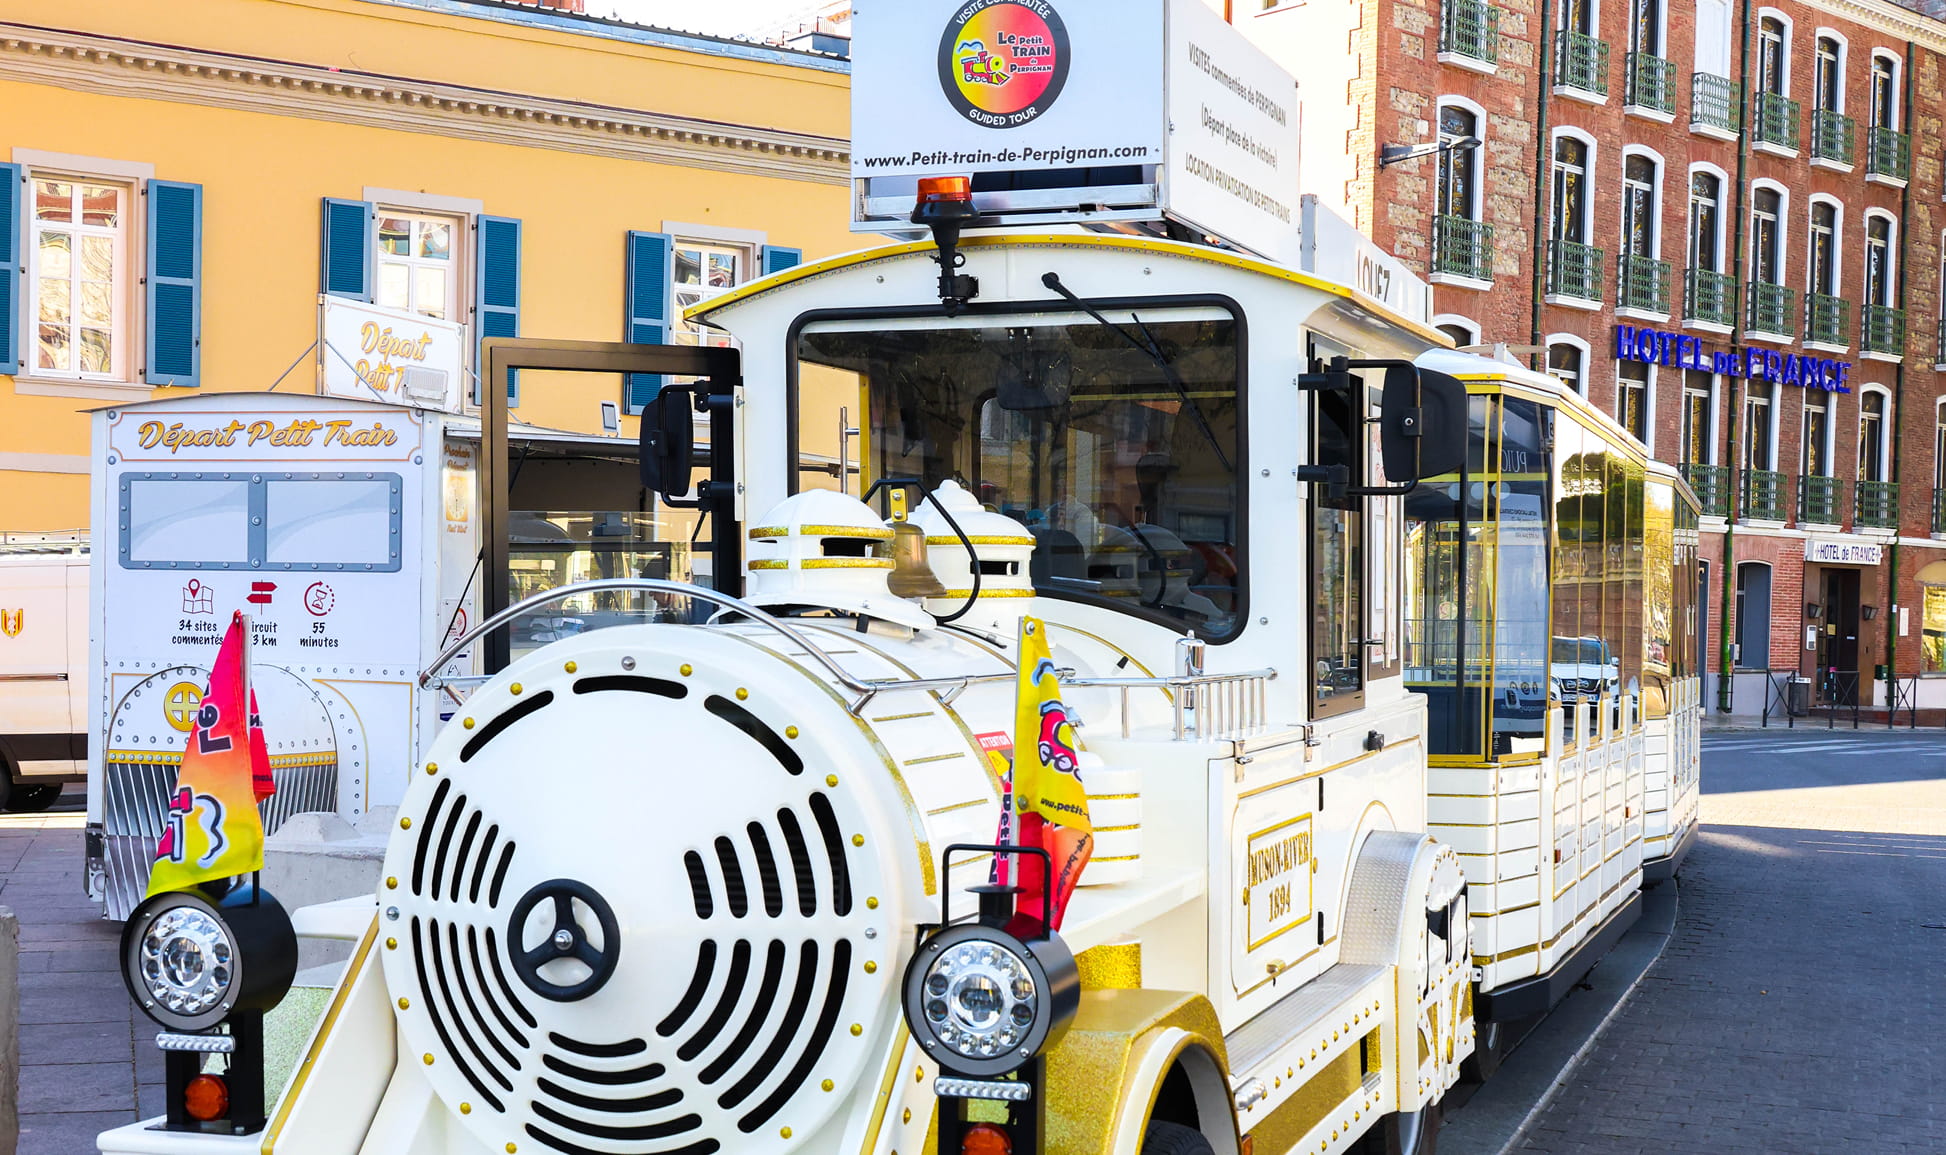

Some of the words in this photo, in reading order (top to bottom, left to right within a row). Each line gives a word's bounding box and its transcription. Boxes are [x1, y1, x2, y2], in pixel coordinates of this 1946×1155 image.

[956, 1, 984, 25] VISITE
[998, 32, 1016, 44] Le
[1012, 46, 1050, 57] TRAIN
[1010, 64, 1051, 72] PERPIGNAN
[1189, 41, 1211, 74] VISITES
[1211, 64, 1247, 100] commentées
[1248, 85, 1255, 105] de
[1256, 90, 1286, 128] PERPIGNAN
[969, 109, 1006, 126] GUIDED
[1009, 106, 1037, 124] TOUR
[1202, 102, 1225, 136] (Départ
[1226, 123, 1241, 145] place
[1242, 131, 1249, 152] de
[1250, 136, 1256, 156] la
[864, 144, 1147, 168] www.Petit-train-de-Perpignan.com
[1185, 152, 1215, 184] LOCATION
[1215, 169, 1254, 204] PRIVATISATION
[1254, 189, 1261, 208] DE
[361, 321, 432, 362] Départ
[1617, 325, 1710, 371] HOTEL
[1746, 347, 1852, 394] FRANCE
[355, 359, 395, 391] Petit
[138, 419, 246, 454] Départ
[247, 419, 323, 447] Petit
[323, 420, 398, 447] Train
[1820, 544, 1839, 560] HOTEL
[1842, 546, 1849, 560] de
[1851, 546, 1876, 562] FRANCE
[179, 620, 192, 631] 34
[195, 620, 217, 631] sites
[251, 621, 277, 633] ircuit
[312, 622, 325, 634] 55
[172, 633, 223, 645] commentés
[262, 635, 277, 646] km
[300, 636, 339, 648] minutes
[1268, 881, 1291, 922] 1894
